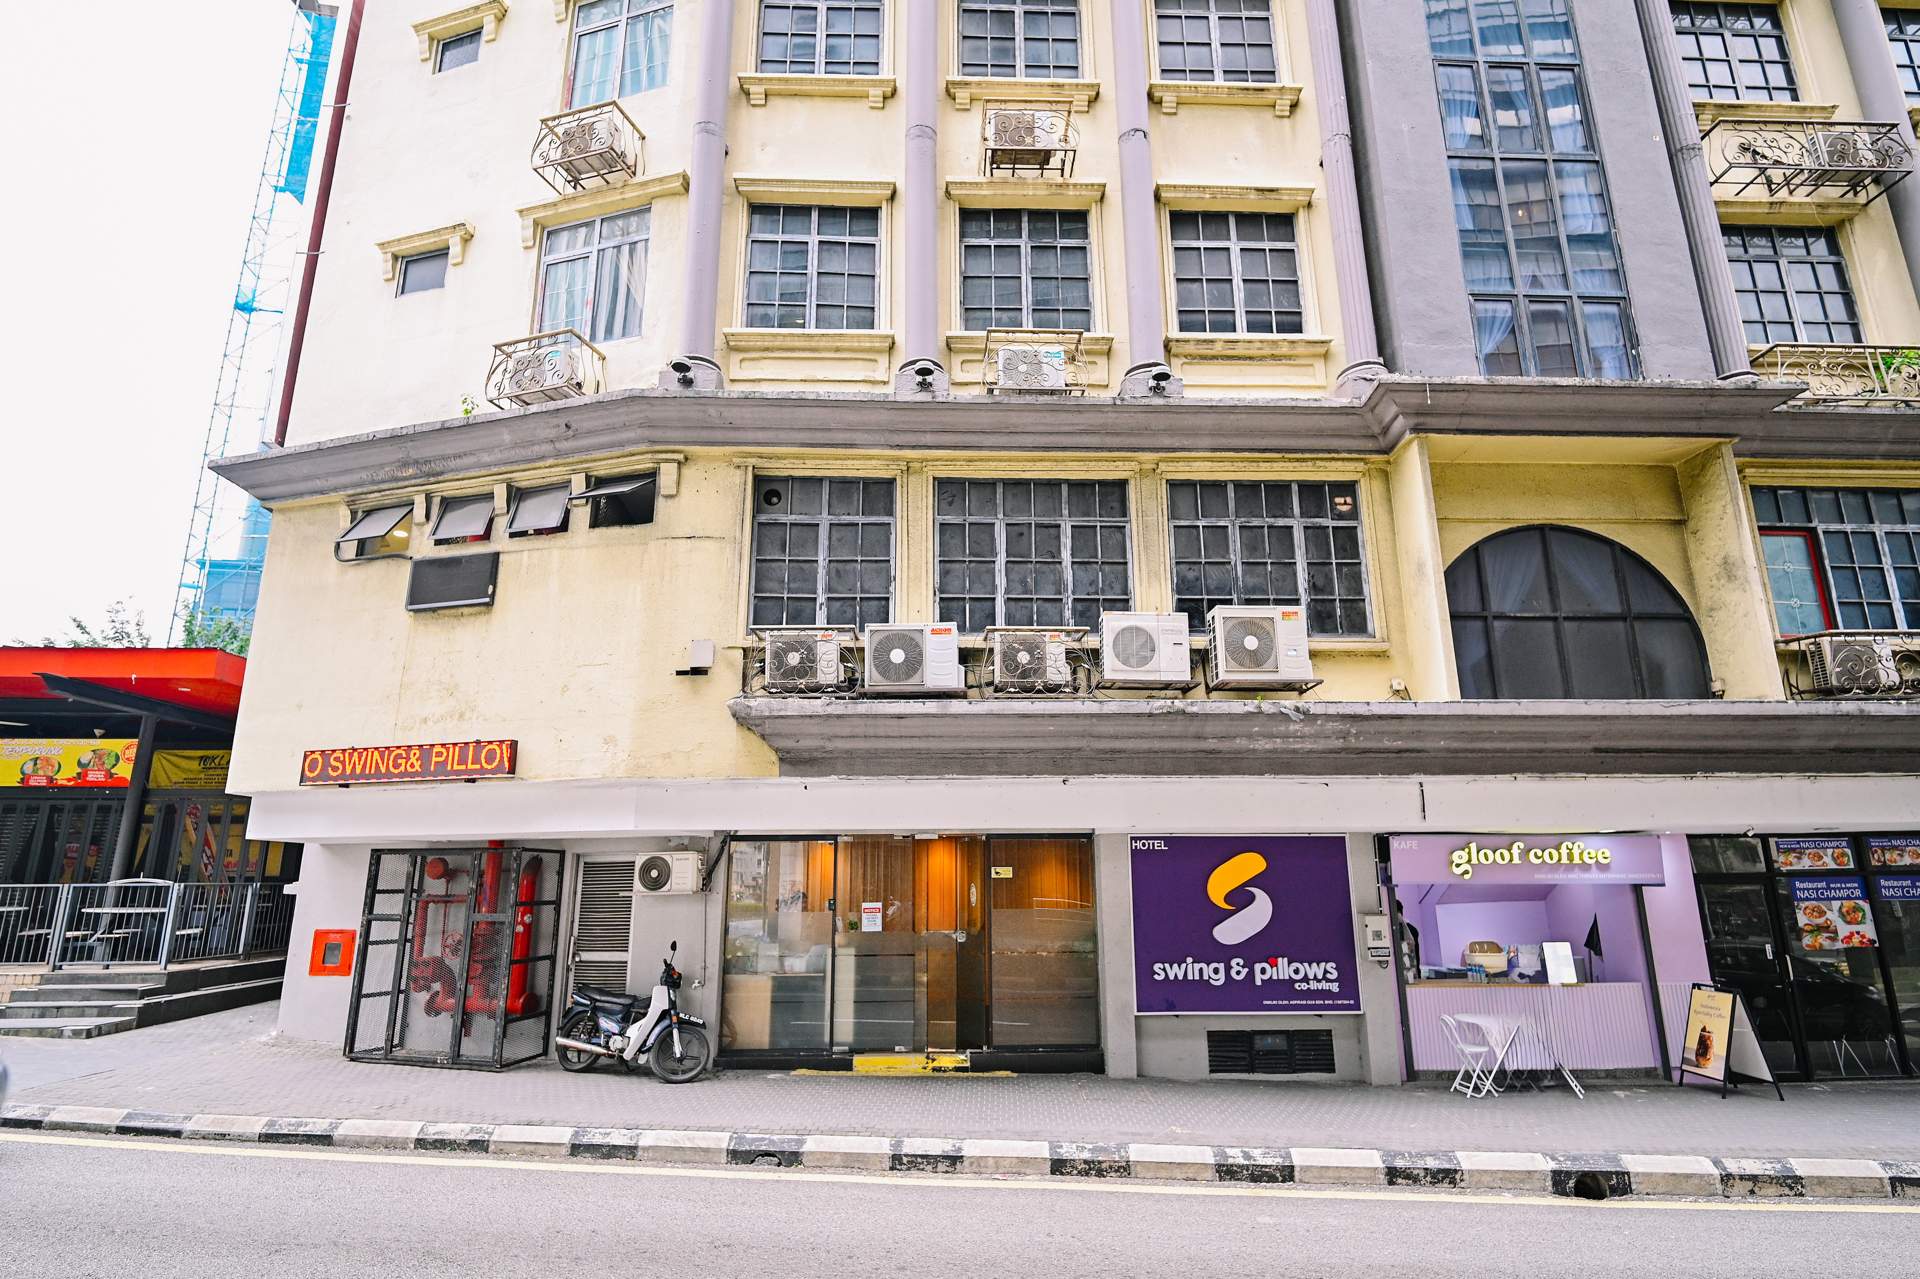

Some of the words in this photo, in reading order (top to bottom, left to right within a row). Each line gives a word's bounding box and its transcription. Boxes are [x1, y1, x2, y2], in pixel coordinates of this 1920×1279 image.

[304, 751, 323, 778] O
[328, 747, 422, 777] SWING&
[1131, 840, 1169, 850] HOTEL
[1393, 840, 1419, 849] KAFE
[1800, 841, 1815, 849] NASI
[1815, 840, 1848, 848] CHAMPOR
[1892, 839, 1907, 847] NASI
[1451, 841, 1524, 880] gloof
[1528, 841, 1612, 865] coffee
[1795, 881, 1826, 889] Restaurant
[1880, 879, 1911, 887] Restaurant
[1796, 889, 1816, 898] NASI
[1818, 888, 1862, 898] CHAMPOR
[1881, 887, 1903, 897] NASI
[1153, 957, 1226, 986] swing
[1230, 957, 1249, 981] &
[1254, 957, 1339, 986] pillows
[1294, 980, 1340, 993] co-living
